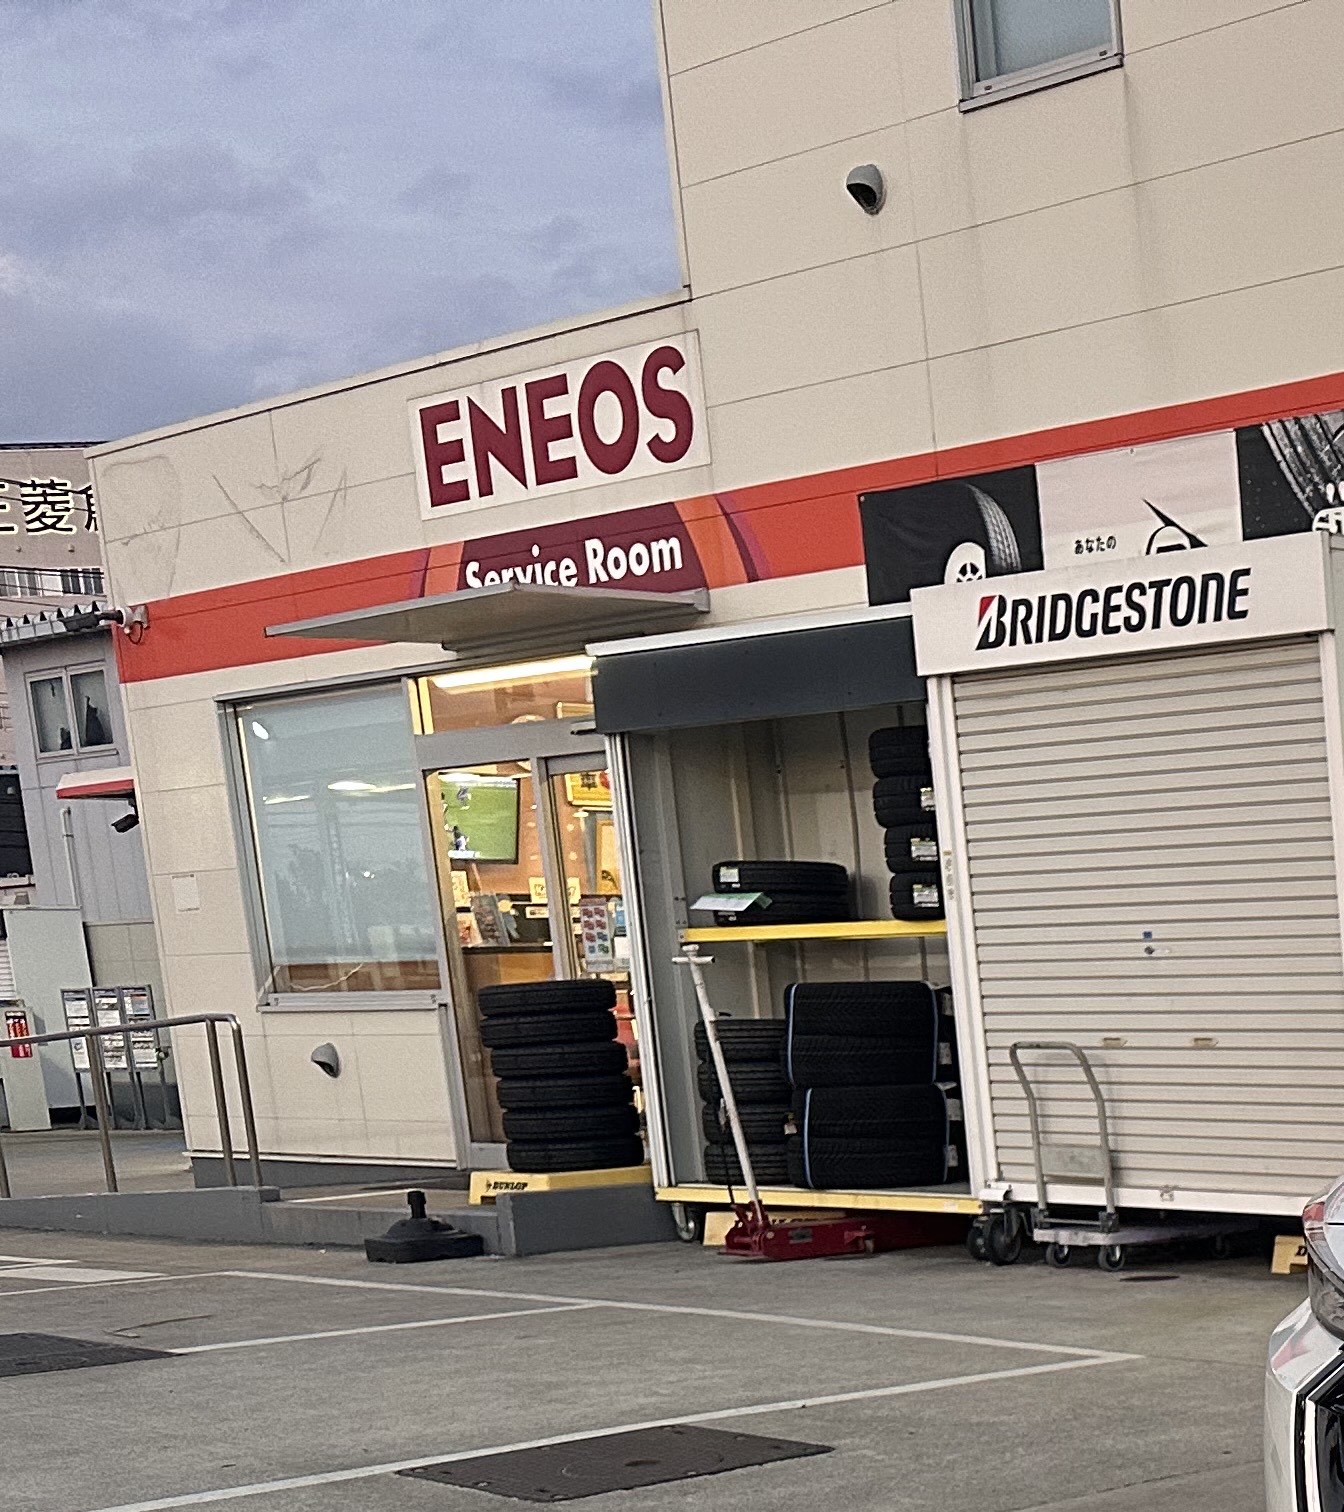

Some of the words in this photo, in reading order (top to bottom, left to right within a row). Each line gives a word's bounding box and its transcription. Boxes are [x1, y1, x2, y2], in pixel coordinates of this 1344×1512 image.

[419, 346, 694, 507] ENEOS
[584, 537, 683, 584] Room
[1074, 535, 1117, 554] あなたの
[975, 568, 1252, 650] BRIDGESTONE
